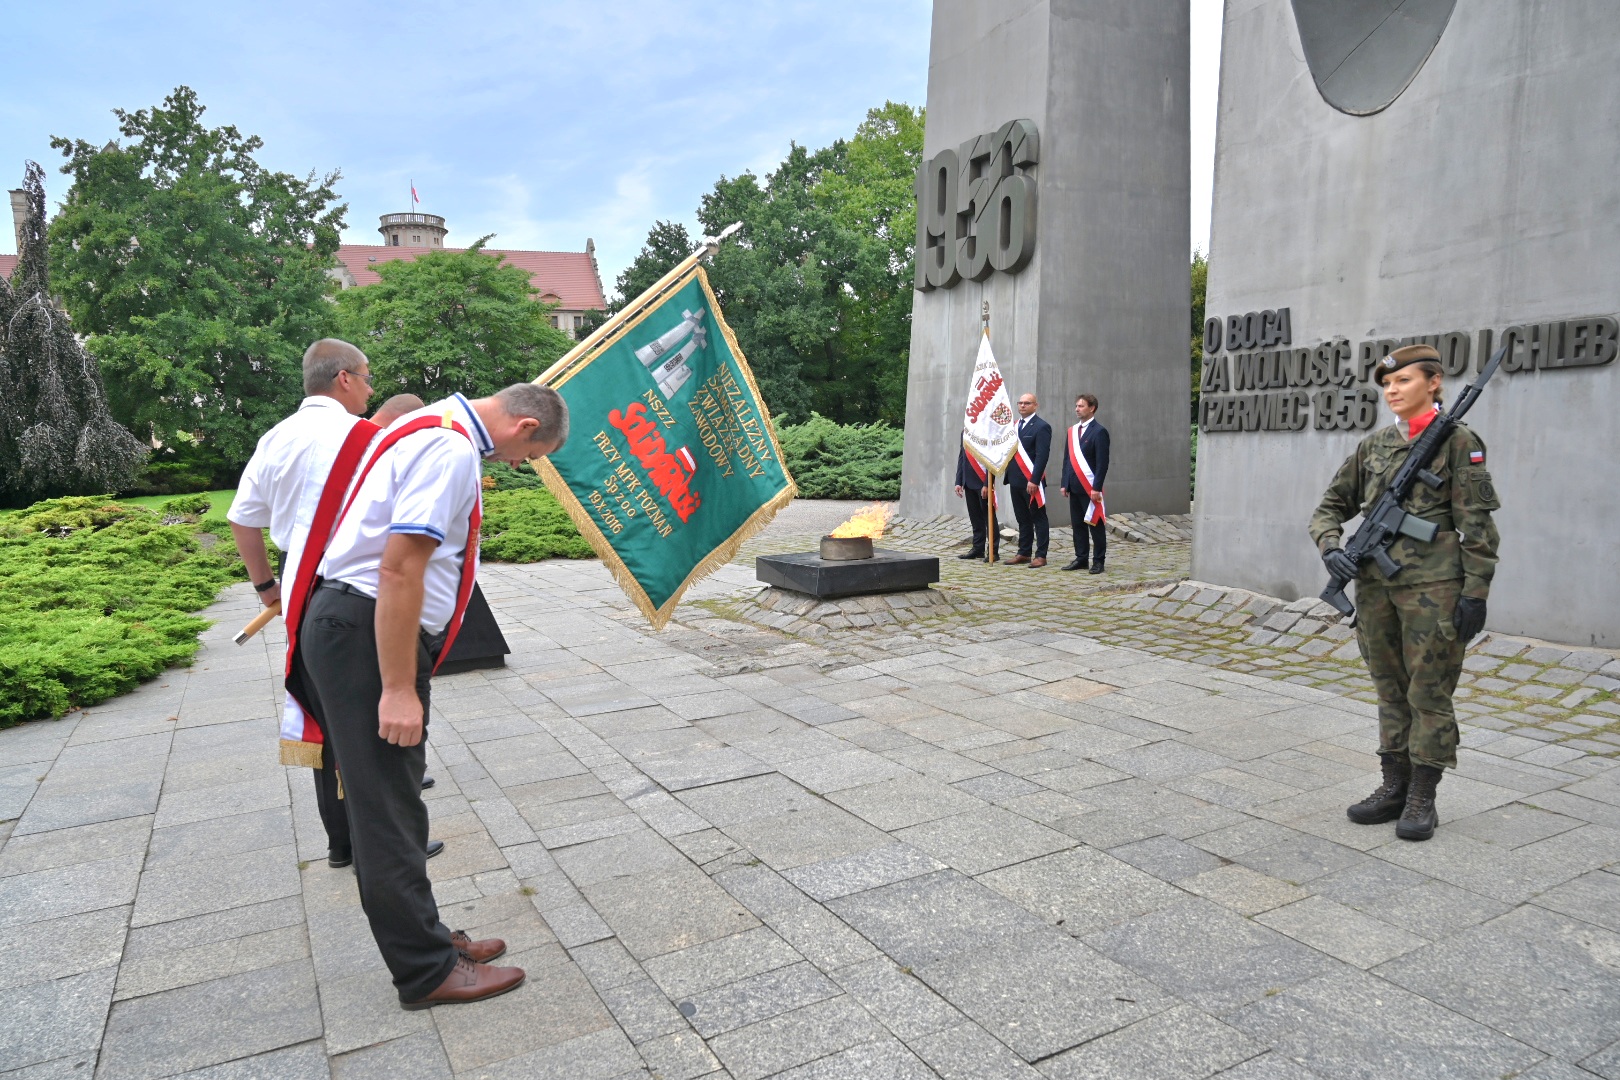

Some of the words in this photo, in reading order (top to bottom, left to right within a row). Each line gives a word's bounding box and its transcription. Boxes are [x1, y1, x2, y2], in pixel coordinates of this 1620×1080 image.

[913, 118, 1039, 293] 1956
[1201, 355, 1229, 392] ZA
[1477, 328, 1494, 373] I
[1500, 316, 1618, 373] CHLEB
[1204, 316, 1222, 354] O
[1226, 307, 1291, 351] BOGA
[642, 388, 676, 429] NSZZ
[688, 394, 734, 478] ZAWODOWY
[1199, 391, 1309, 433] CZERWIEC
[1312, 388, 1379, 431] 1956
[593, 430, 622, 464] PRZY
[615, 461, 641, 493] MPK
